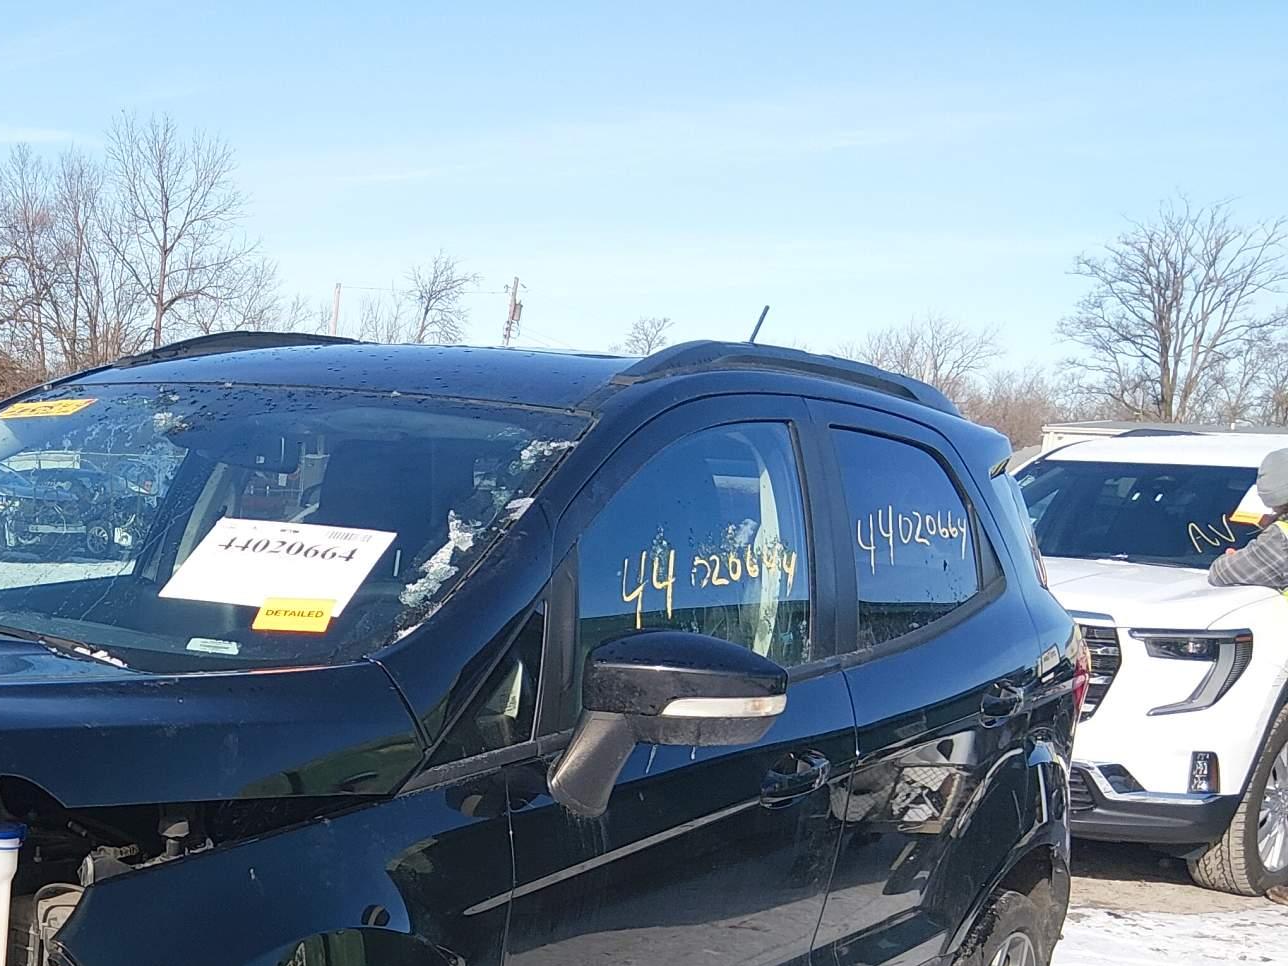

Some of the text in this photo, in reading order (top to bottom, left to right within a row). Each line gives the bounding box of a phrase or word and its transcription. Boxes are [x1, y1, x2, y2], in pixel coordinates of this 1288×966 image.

[217, 536, 360, 562] 44020664
[857, 504, 967, 576] 44020664
[264, 608, 325, 619] DETAILED
